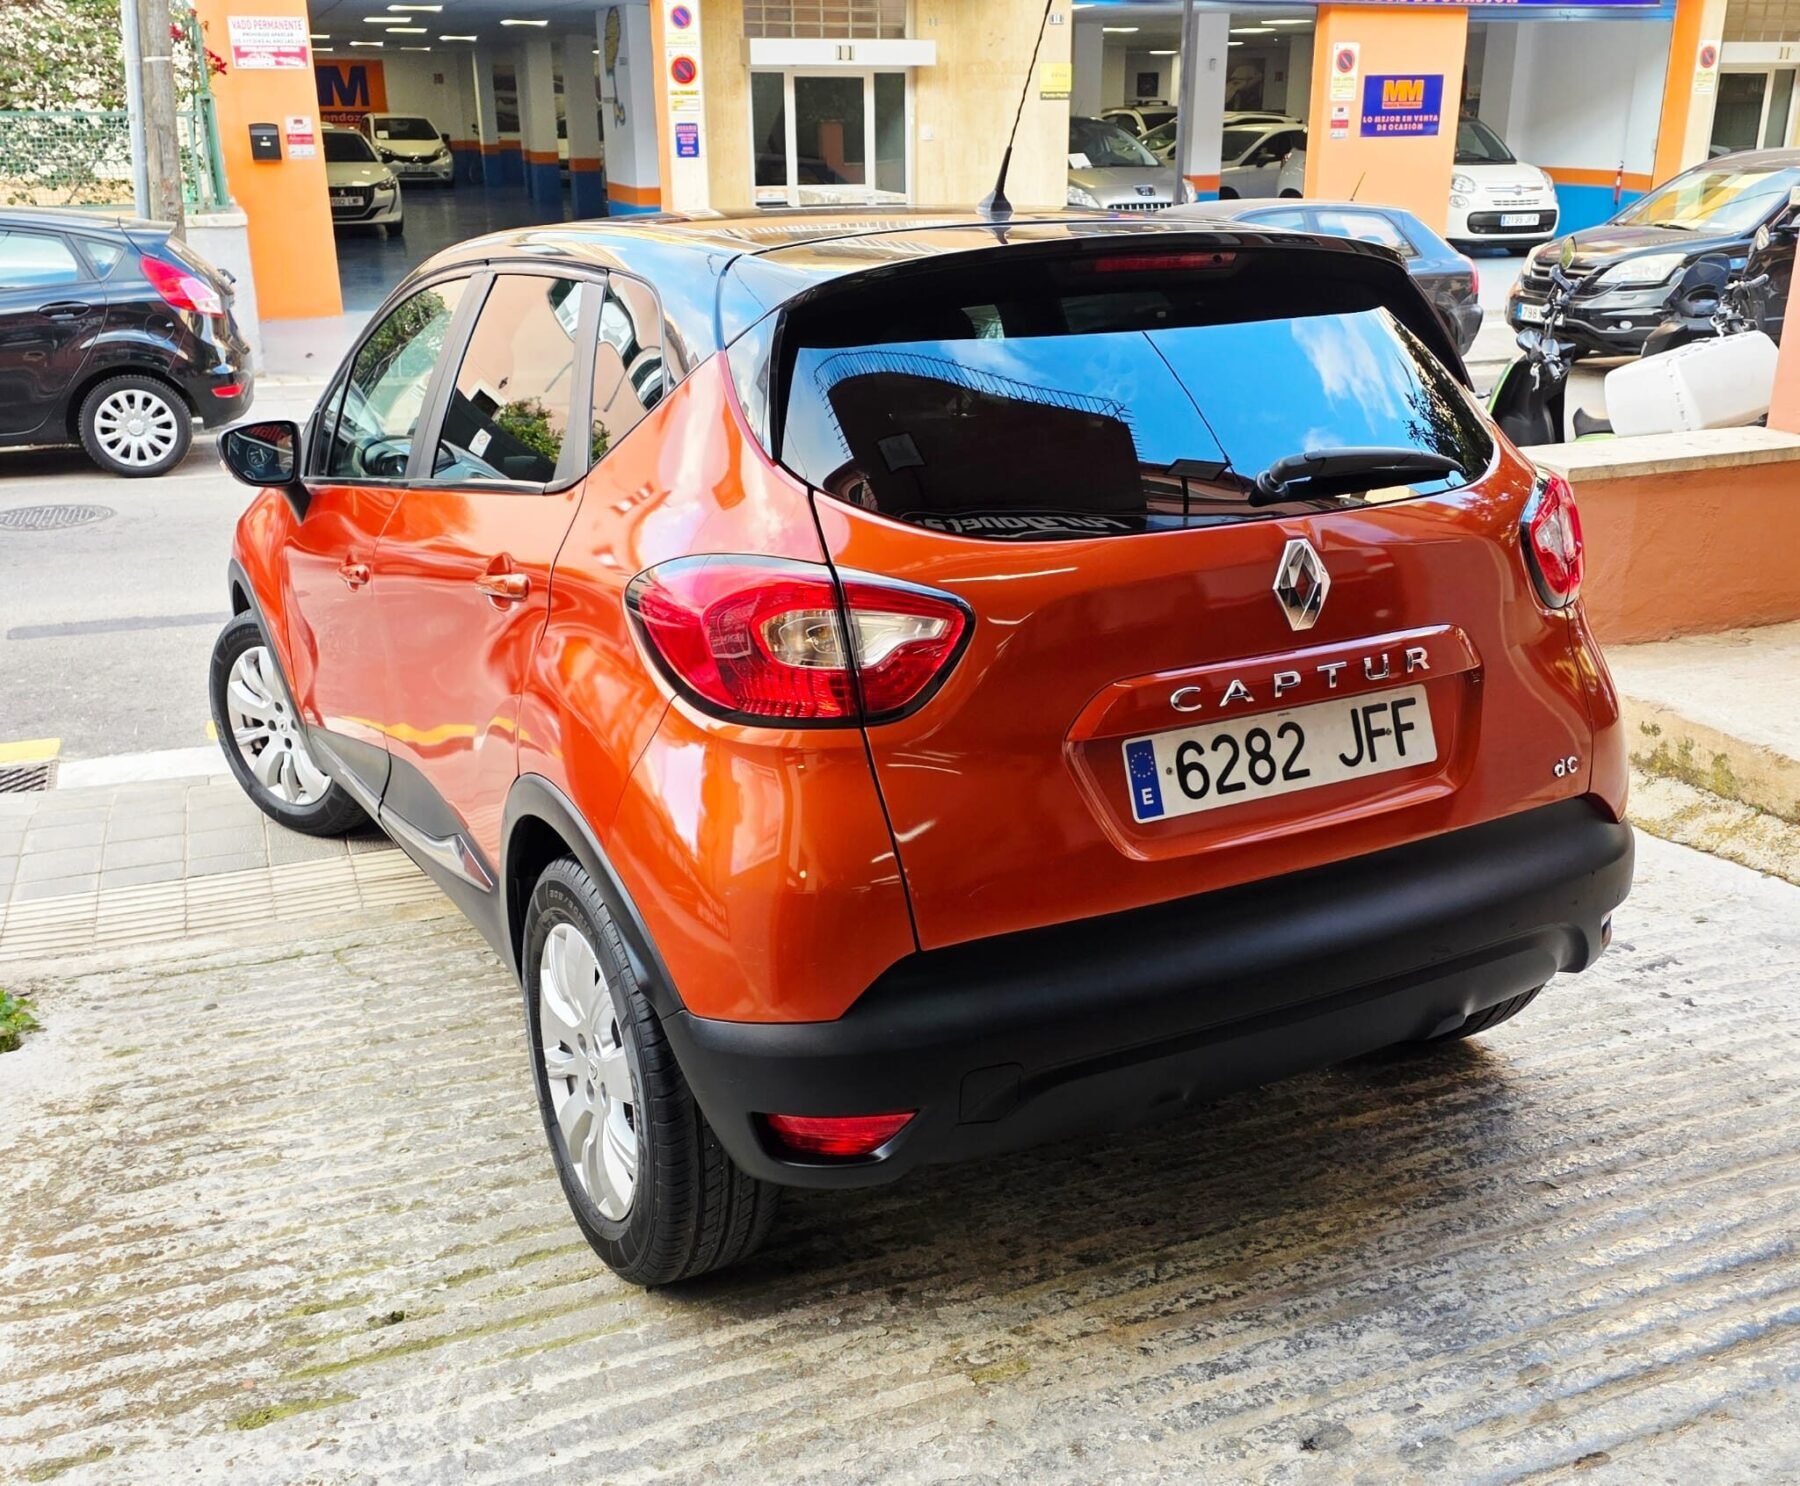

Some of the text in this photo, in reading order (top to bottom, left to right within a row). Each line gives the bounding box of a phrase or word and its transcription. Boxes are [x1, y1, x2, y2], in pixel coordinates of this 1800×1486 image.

[231, 20, 302, 30] VADO PERMANENTE
[838, 46, 852, 60] 11
[1383, 79, 1424, 102] MM
[322, 112, 362, 122] endoz
[1374, 115, 1400, 123] MEJOR
[1413, 114, 1439, 122] VENTA
[1376, 123, 1387, 131] DE
[1170, 647, 1430, 712] CAPTUR
[1175, 697, 1417, 800] 6282 JFF
[1141, 787, 1154, 805] E
